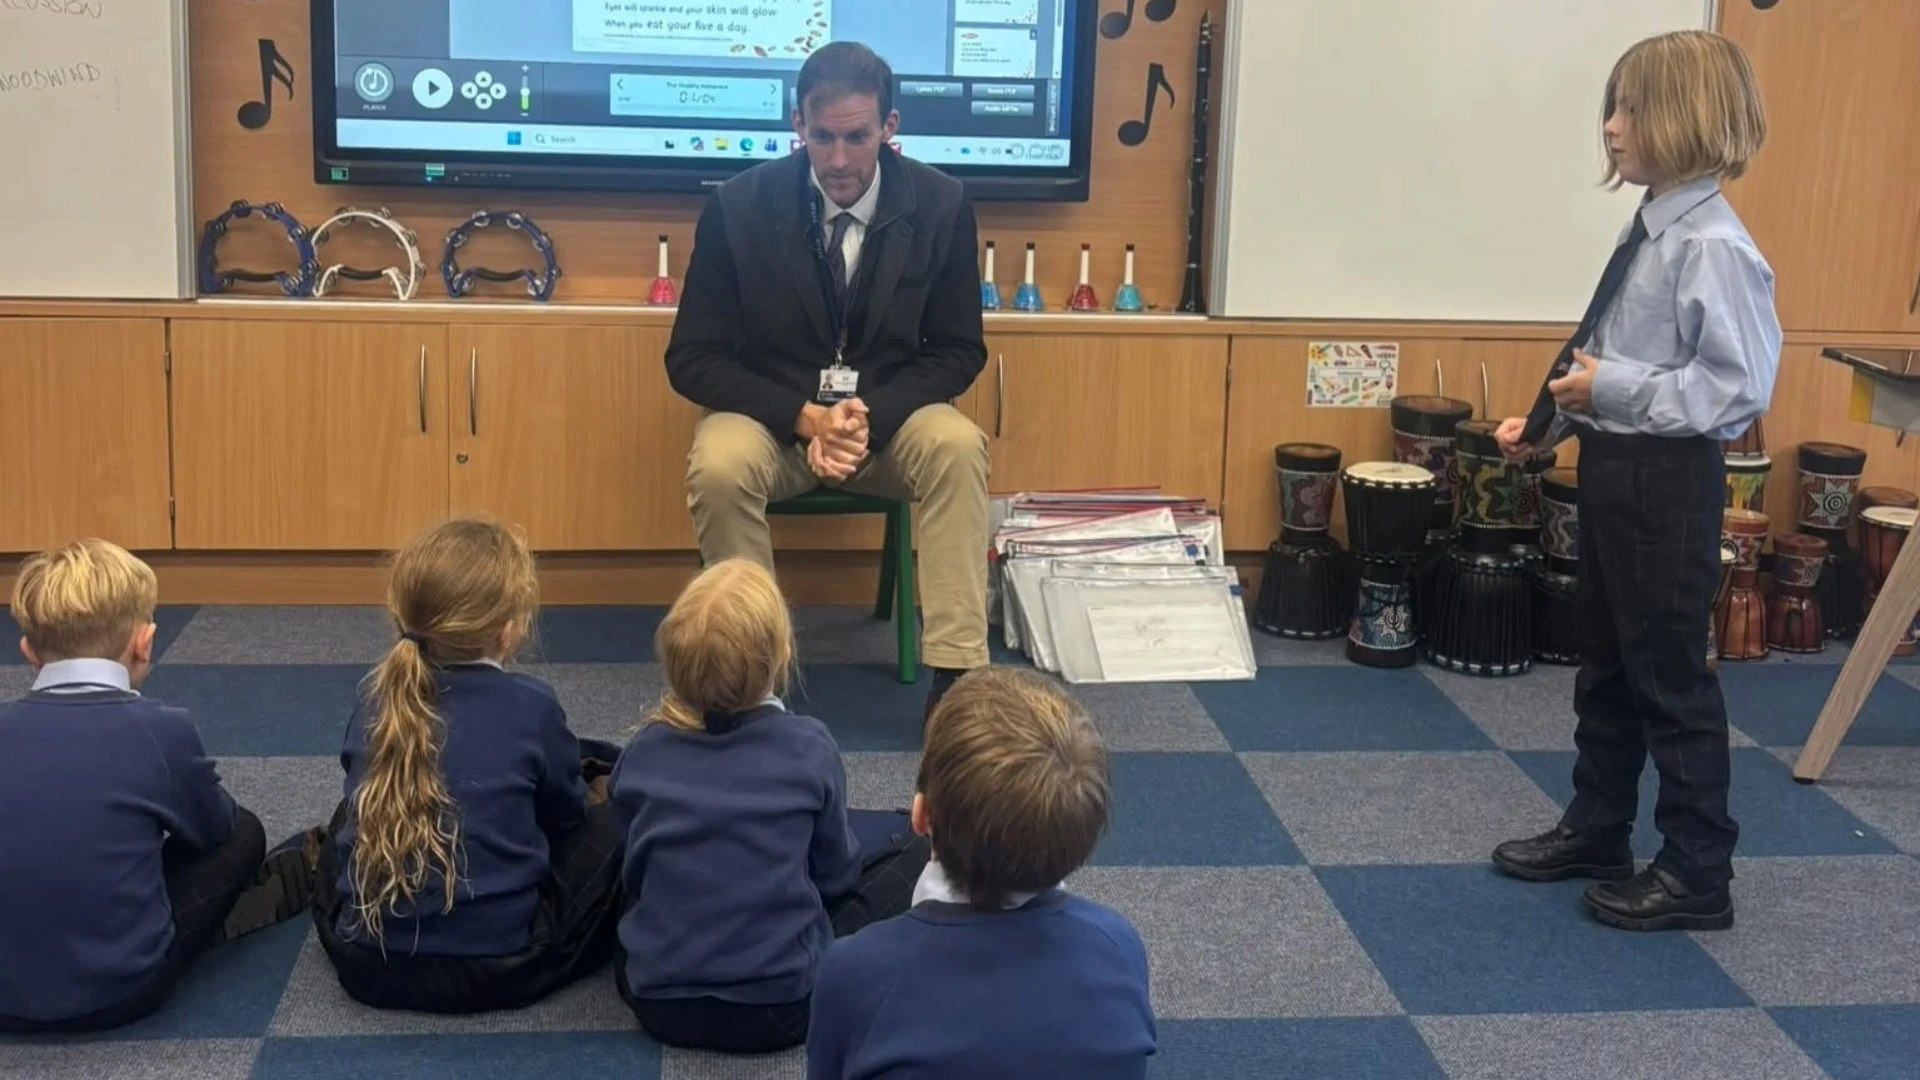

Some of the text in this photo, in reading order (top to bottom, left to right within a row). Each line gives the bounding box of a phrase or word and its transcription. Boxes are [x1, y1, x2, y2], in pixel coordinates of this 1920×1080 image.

[604, 2, 777, 19] Eyes will sparkle and your skin will glow
[604, 20, 627, 28] When
[629, 22, 644, 31] you
[647, 20, 663, 30] eat
[667, 22, 692, 33] your
[695, 19, 713, 31] five
[717, 22, 724, 32] a
[362, 103, 387, 112] PLAYER
